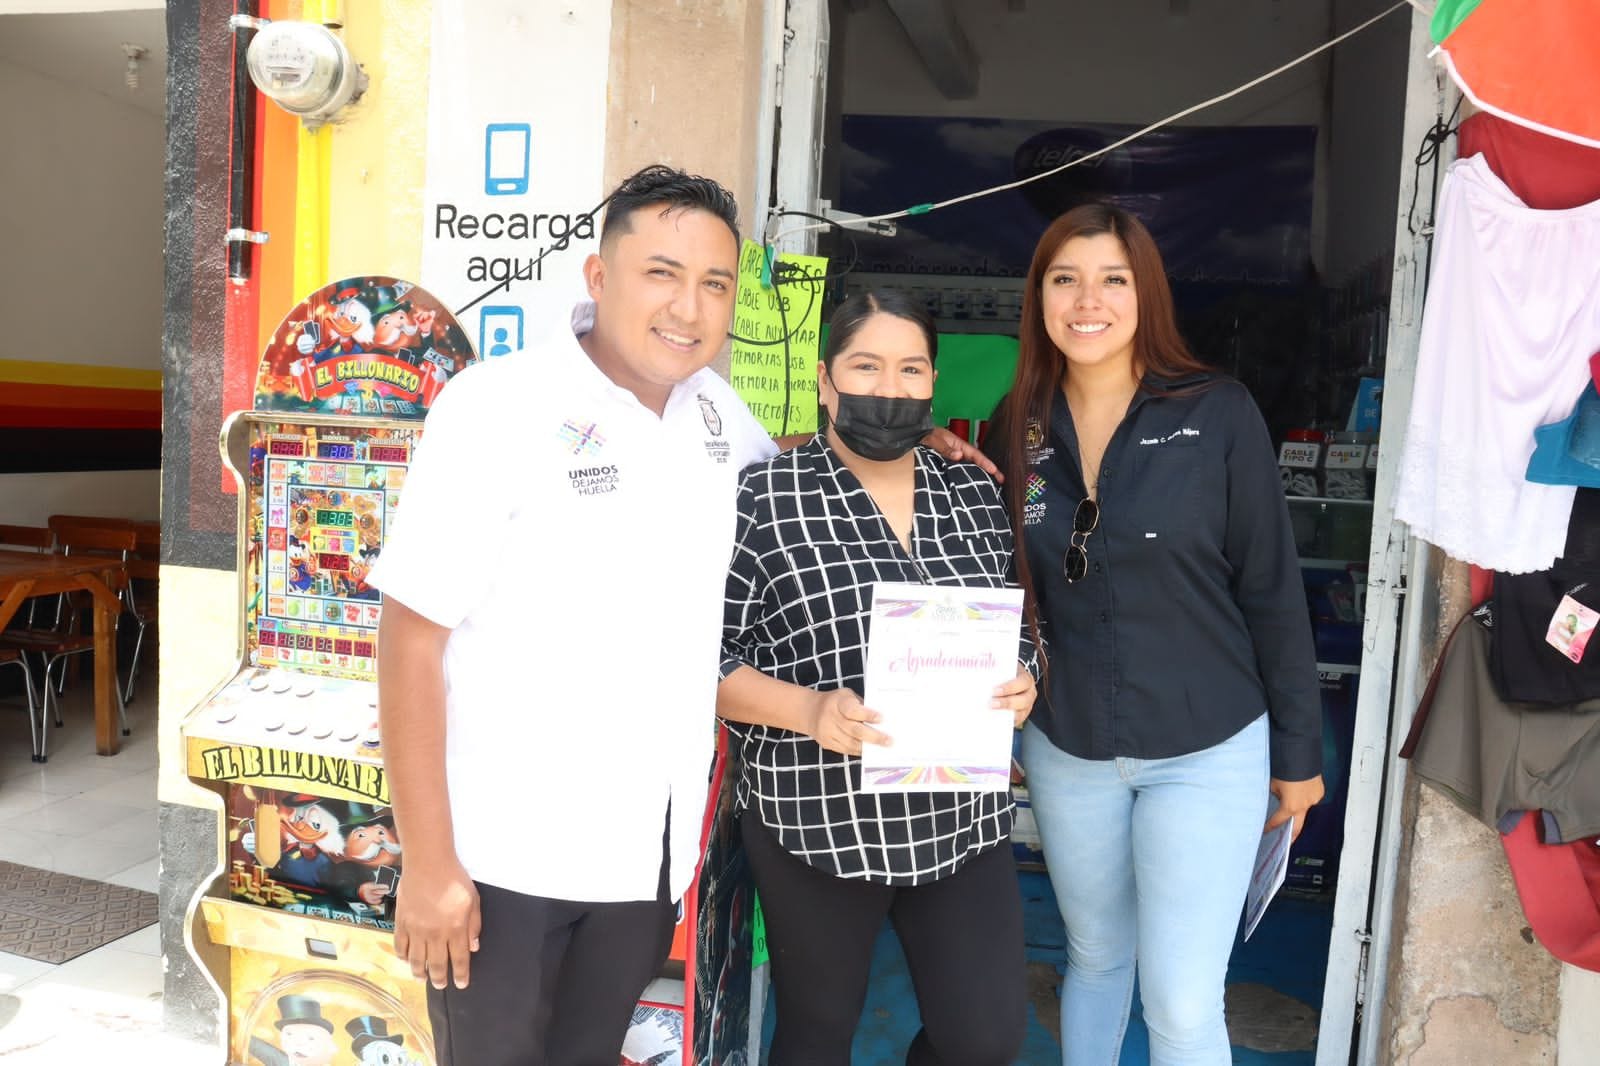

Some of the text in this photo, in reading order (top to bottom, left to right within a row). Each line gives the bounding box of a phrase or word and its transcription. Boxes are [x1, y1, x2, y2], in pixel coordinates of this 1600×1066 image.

[435, 203, 595, 250] Recarga
[737, 286, 791, 312] CABLE USB
[734, 316, 761, 340] CABLE
[732, 349, 782, 368] MEMORIAS
[316, 360, 420, 393] EL BILLONARIO
[732, 375, 779, 393] MEMORIA
[568, 464, 618, 479] UNIDOS
[572, 474, 620, 489] DEJAMOS
[579, 484, 617, 497] HUELLA
[888, 646, 998, 679] Agradecimiento
[202, 746, 391, 804] EL BILLONARI
